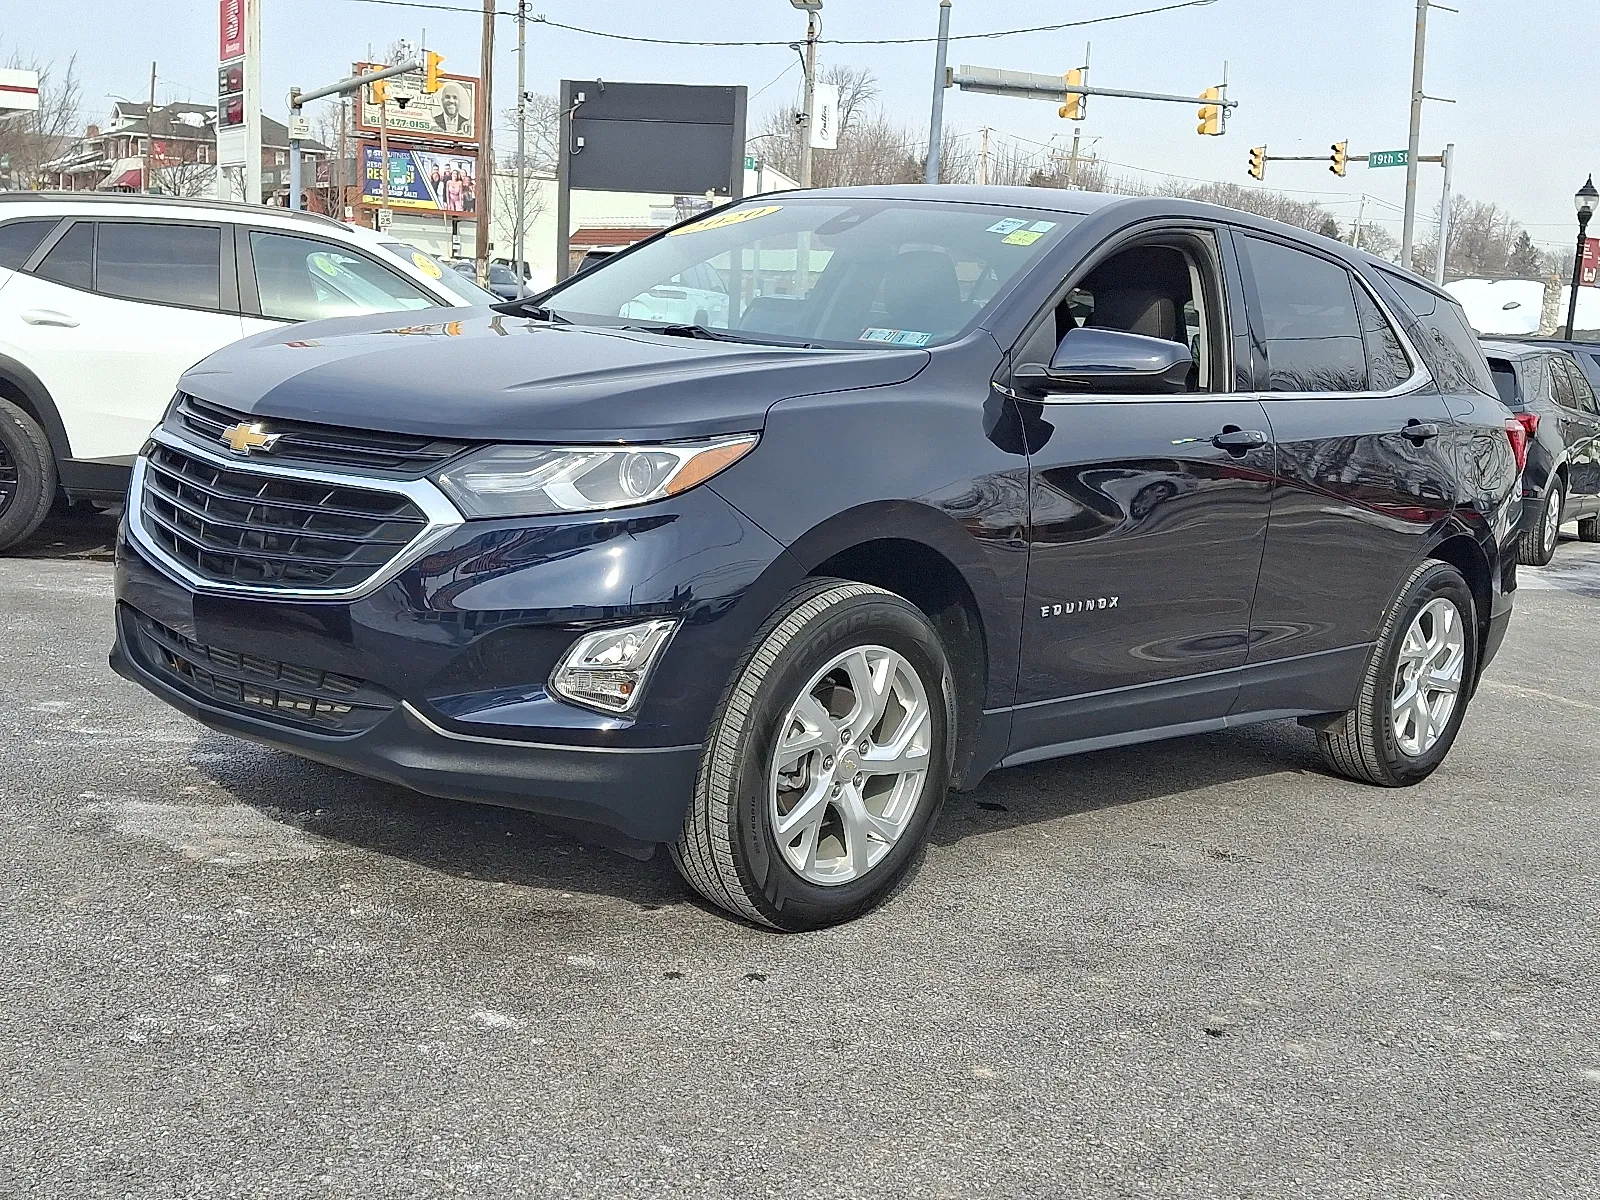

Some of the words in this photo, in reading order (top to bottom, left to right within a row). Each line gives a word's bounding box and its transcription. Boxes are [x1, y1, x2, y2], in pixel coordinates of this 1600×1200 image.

[1373, 154, 1394, 165] 19th
[1397, 152, 1408, 163] St
[1040, 596, 1119, 617] EQUINOX
